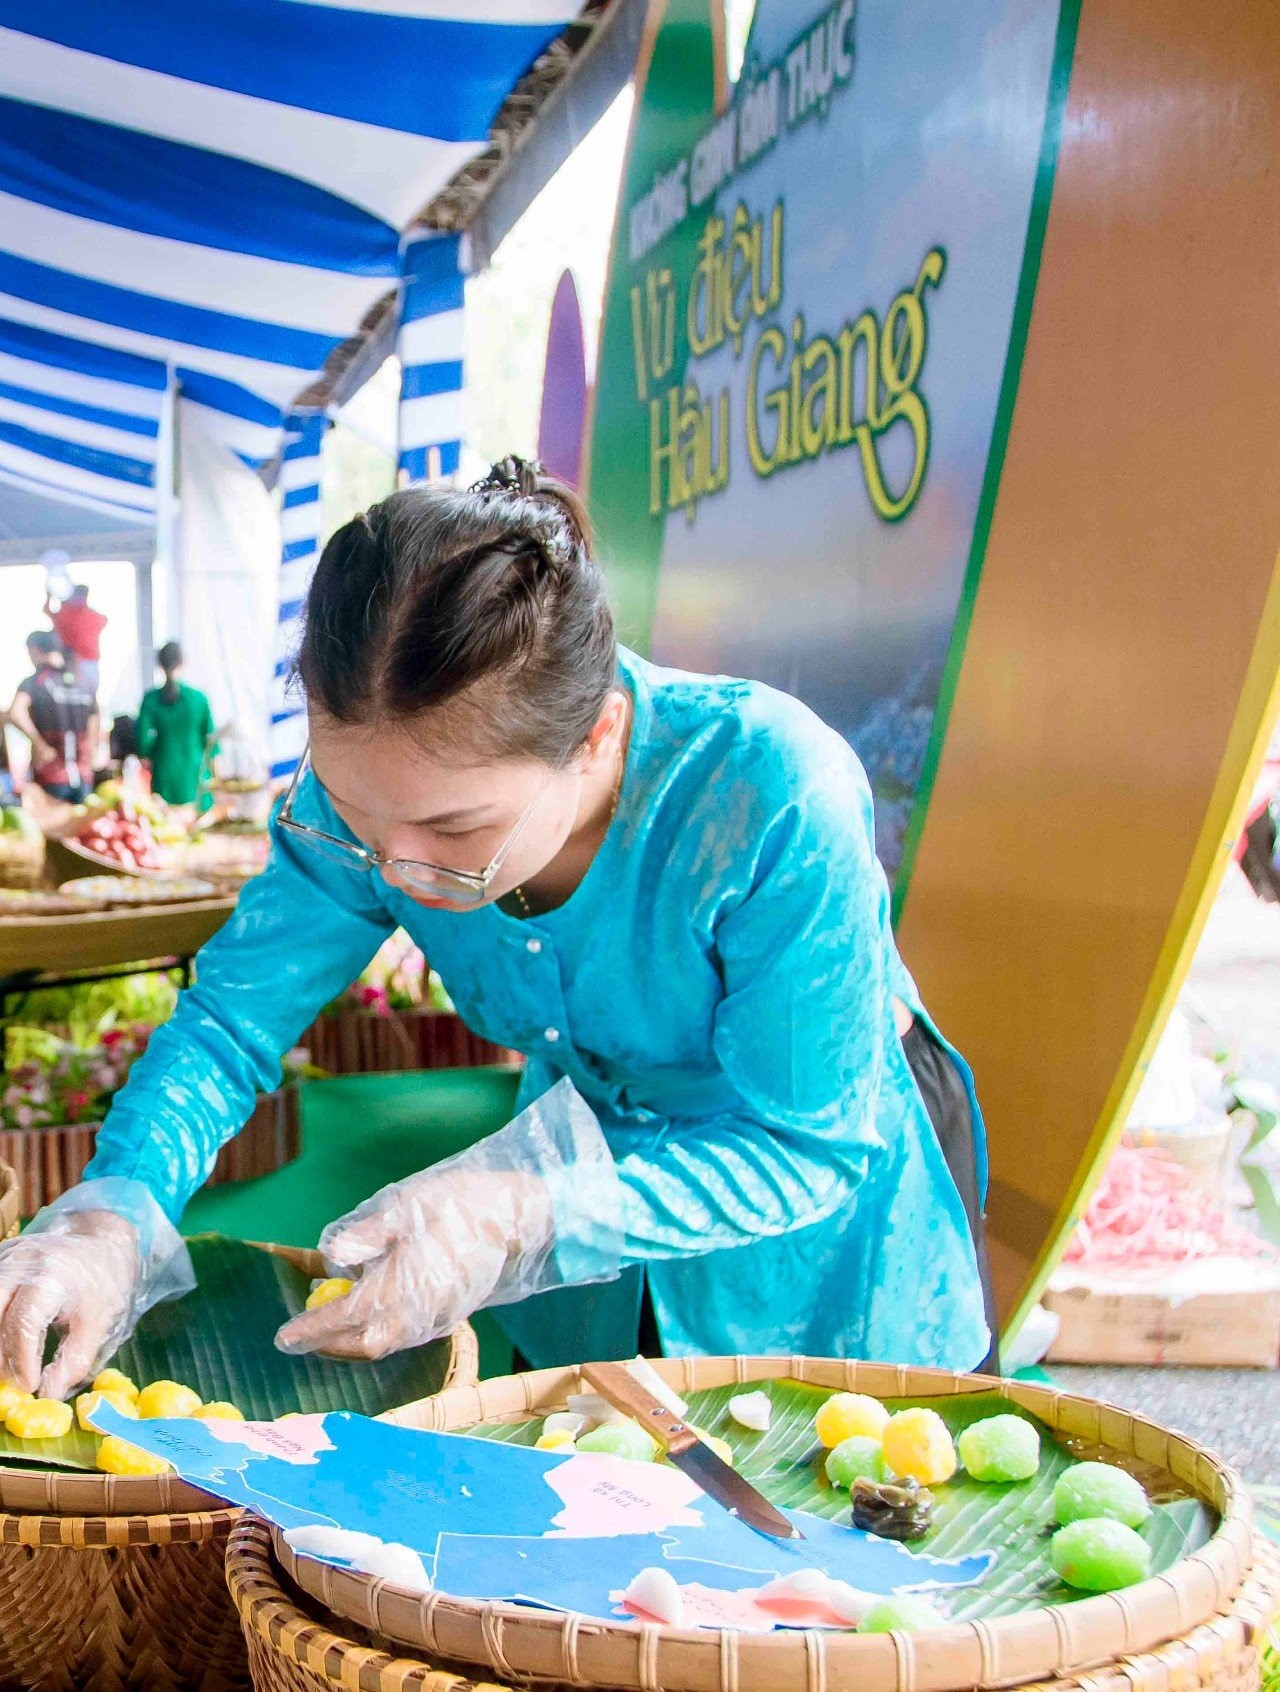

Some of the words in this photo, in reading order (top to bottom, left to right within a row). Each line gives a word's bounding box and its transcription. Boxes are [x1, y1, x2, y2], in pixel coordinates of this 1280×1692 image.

[787, 0, 856, 122] THỰC
[630, 267, 675, 400] Vũ
[687, 202, 784, 358] điệu
[649, 384, 730, 521] Hậu
[746, 249, 945, 520] Giang
